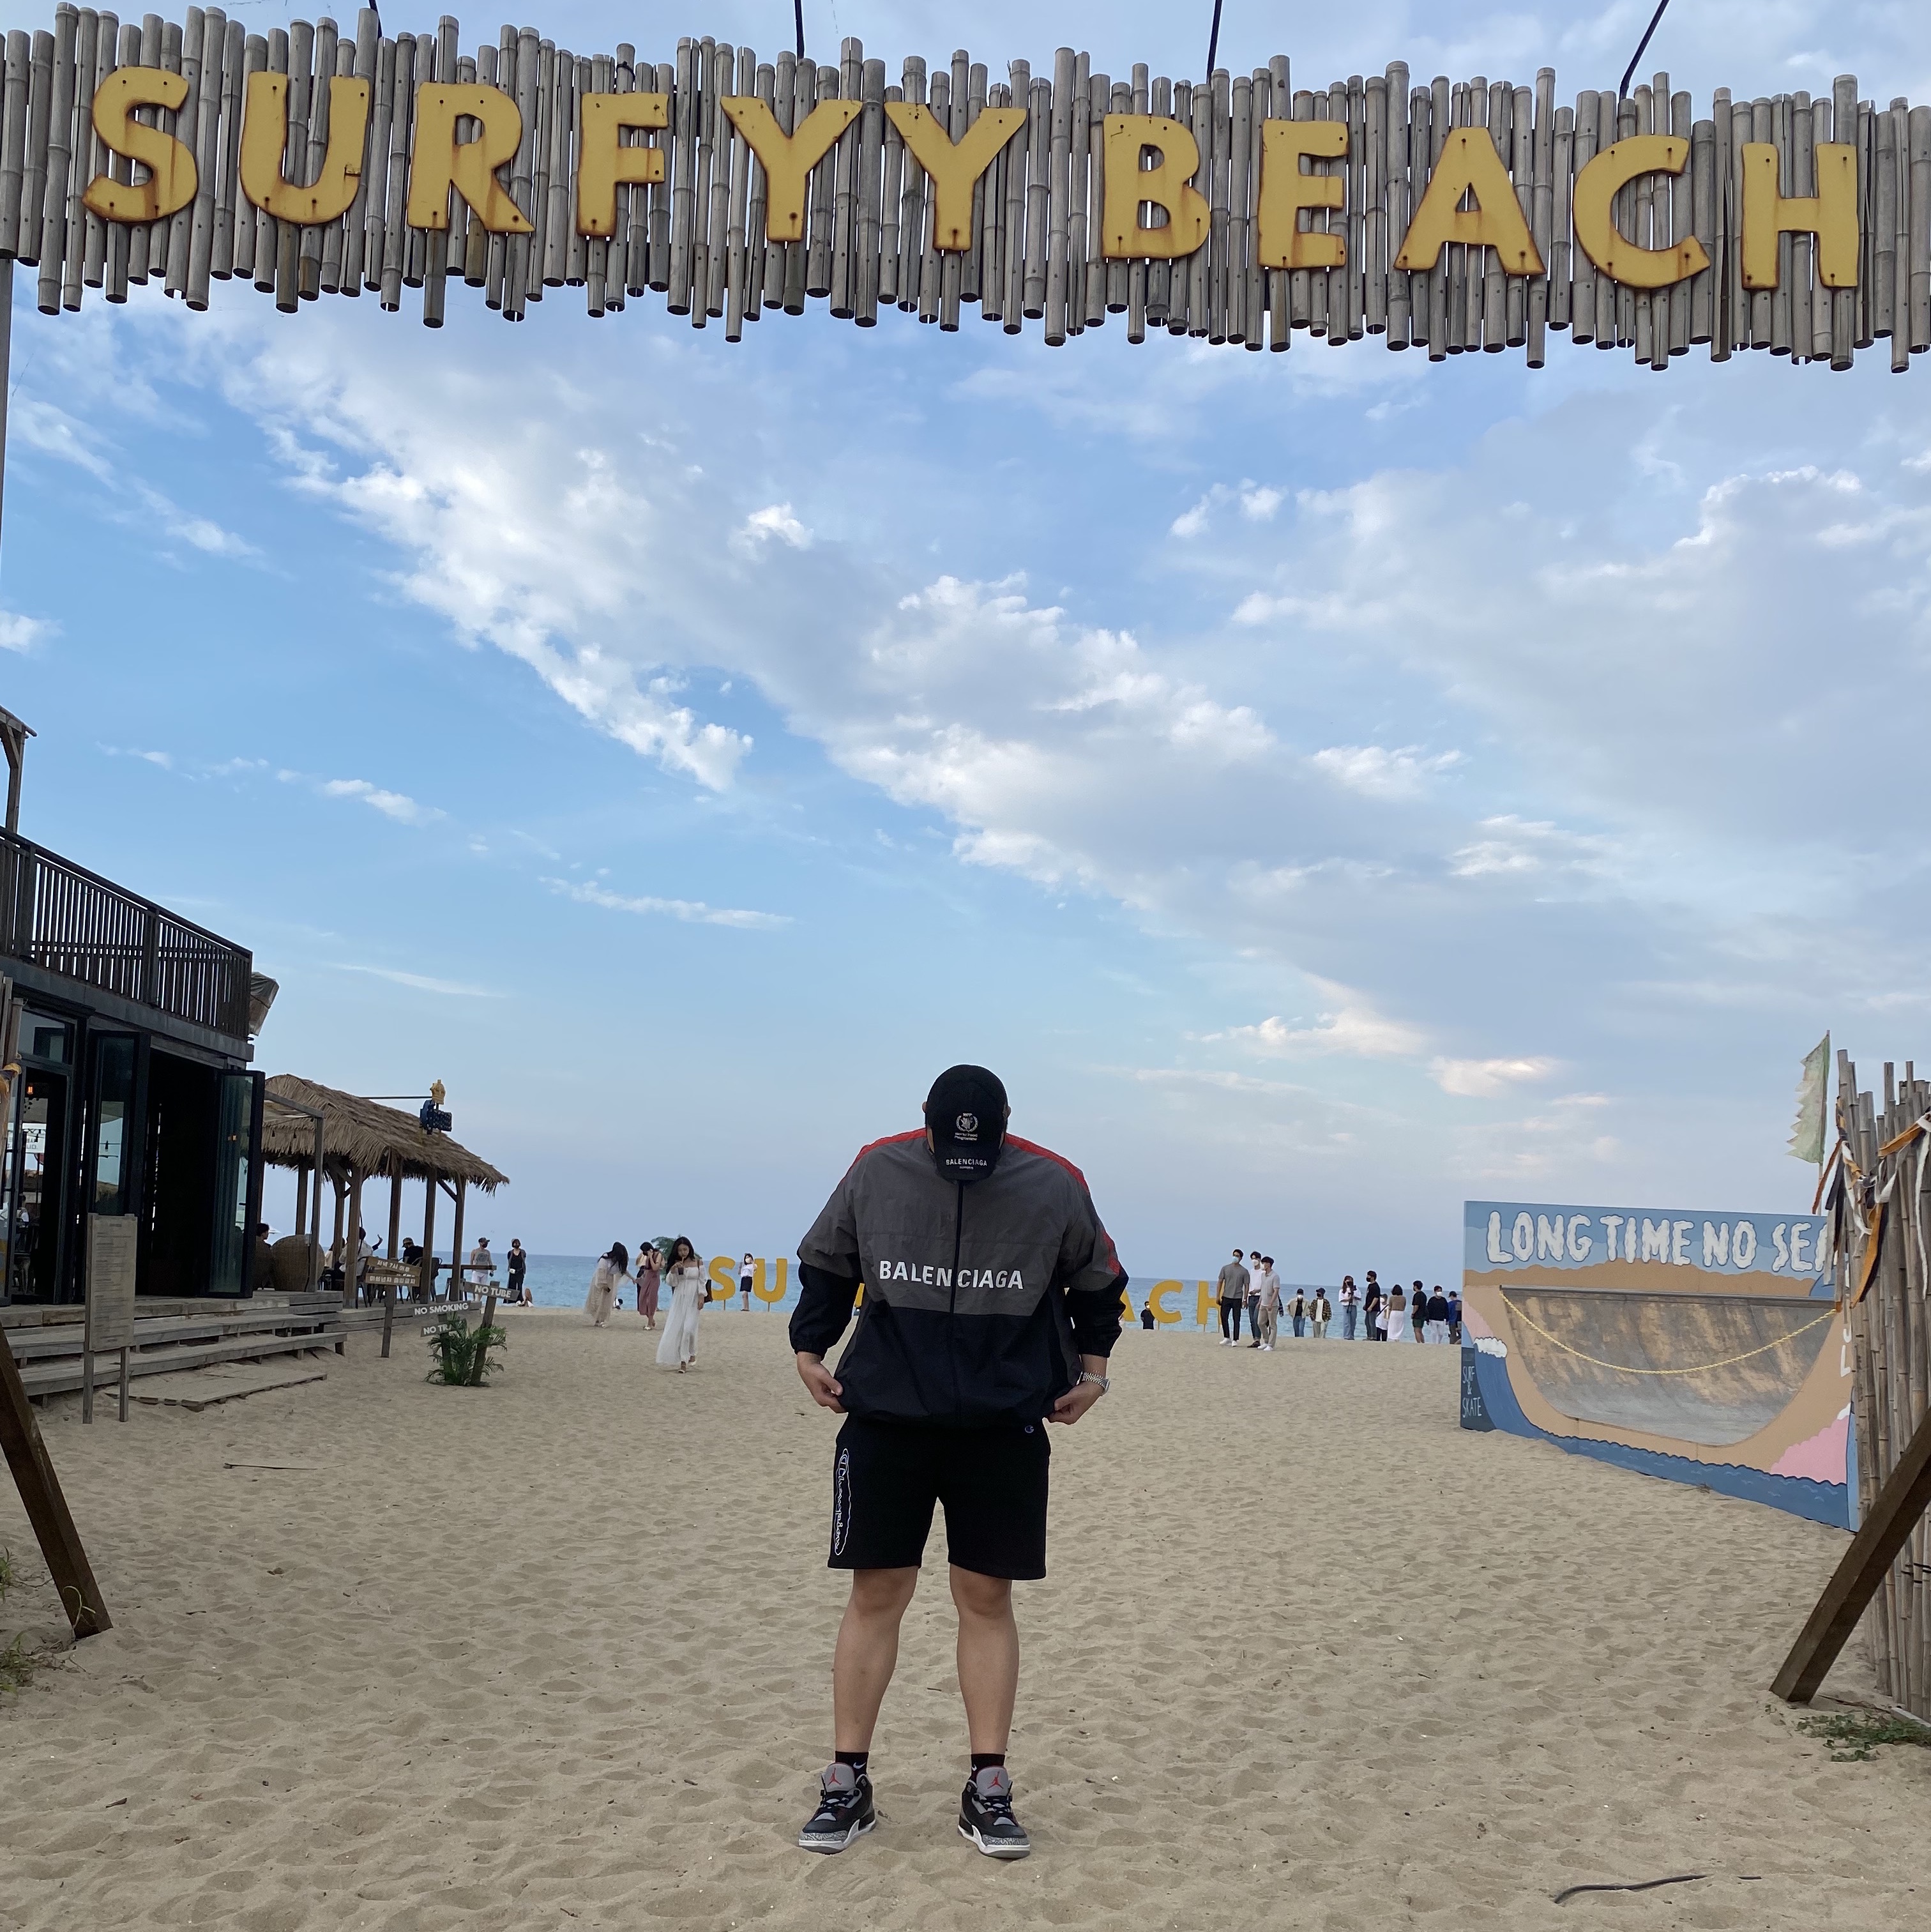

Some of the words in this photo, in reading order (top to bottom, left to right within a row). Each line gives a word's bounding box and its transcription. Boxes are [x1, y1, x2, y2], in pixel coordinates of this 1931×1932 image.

[82, 66, 1027, 251] SURFYY
[1102, 113, 1860, 289] BEACH
[946, 1158, 987, 1166] BALENCIAGA
[1486, 1210, 1593, 1263] LONG
[1599, 1213, 1695, 1266] TIME
[1702, 1219, 1757, 1270] NO
[879, 1259, 1024, 1289] BALENCIAGA
[474, 1284, 488, 1294] NO
[491, 1287, 512, 1298] TUBE
[429, 1302, 469, 1314] SMOKING
[423, 1325, 436, 1335] NO
[1462, 1366, 1475, 1384] SURF
[1462, 1397, 1482, 1418] SKATE
